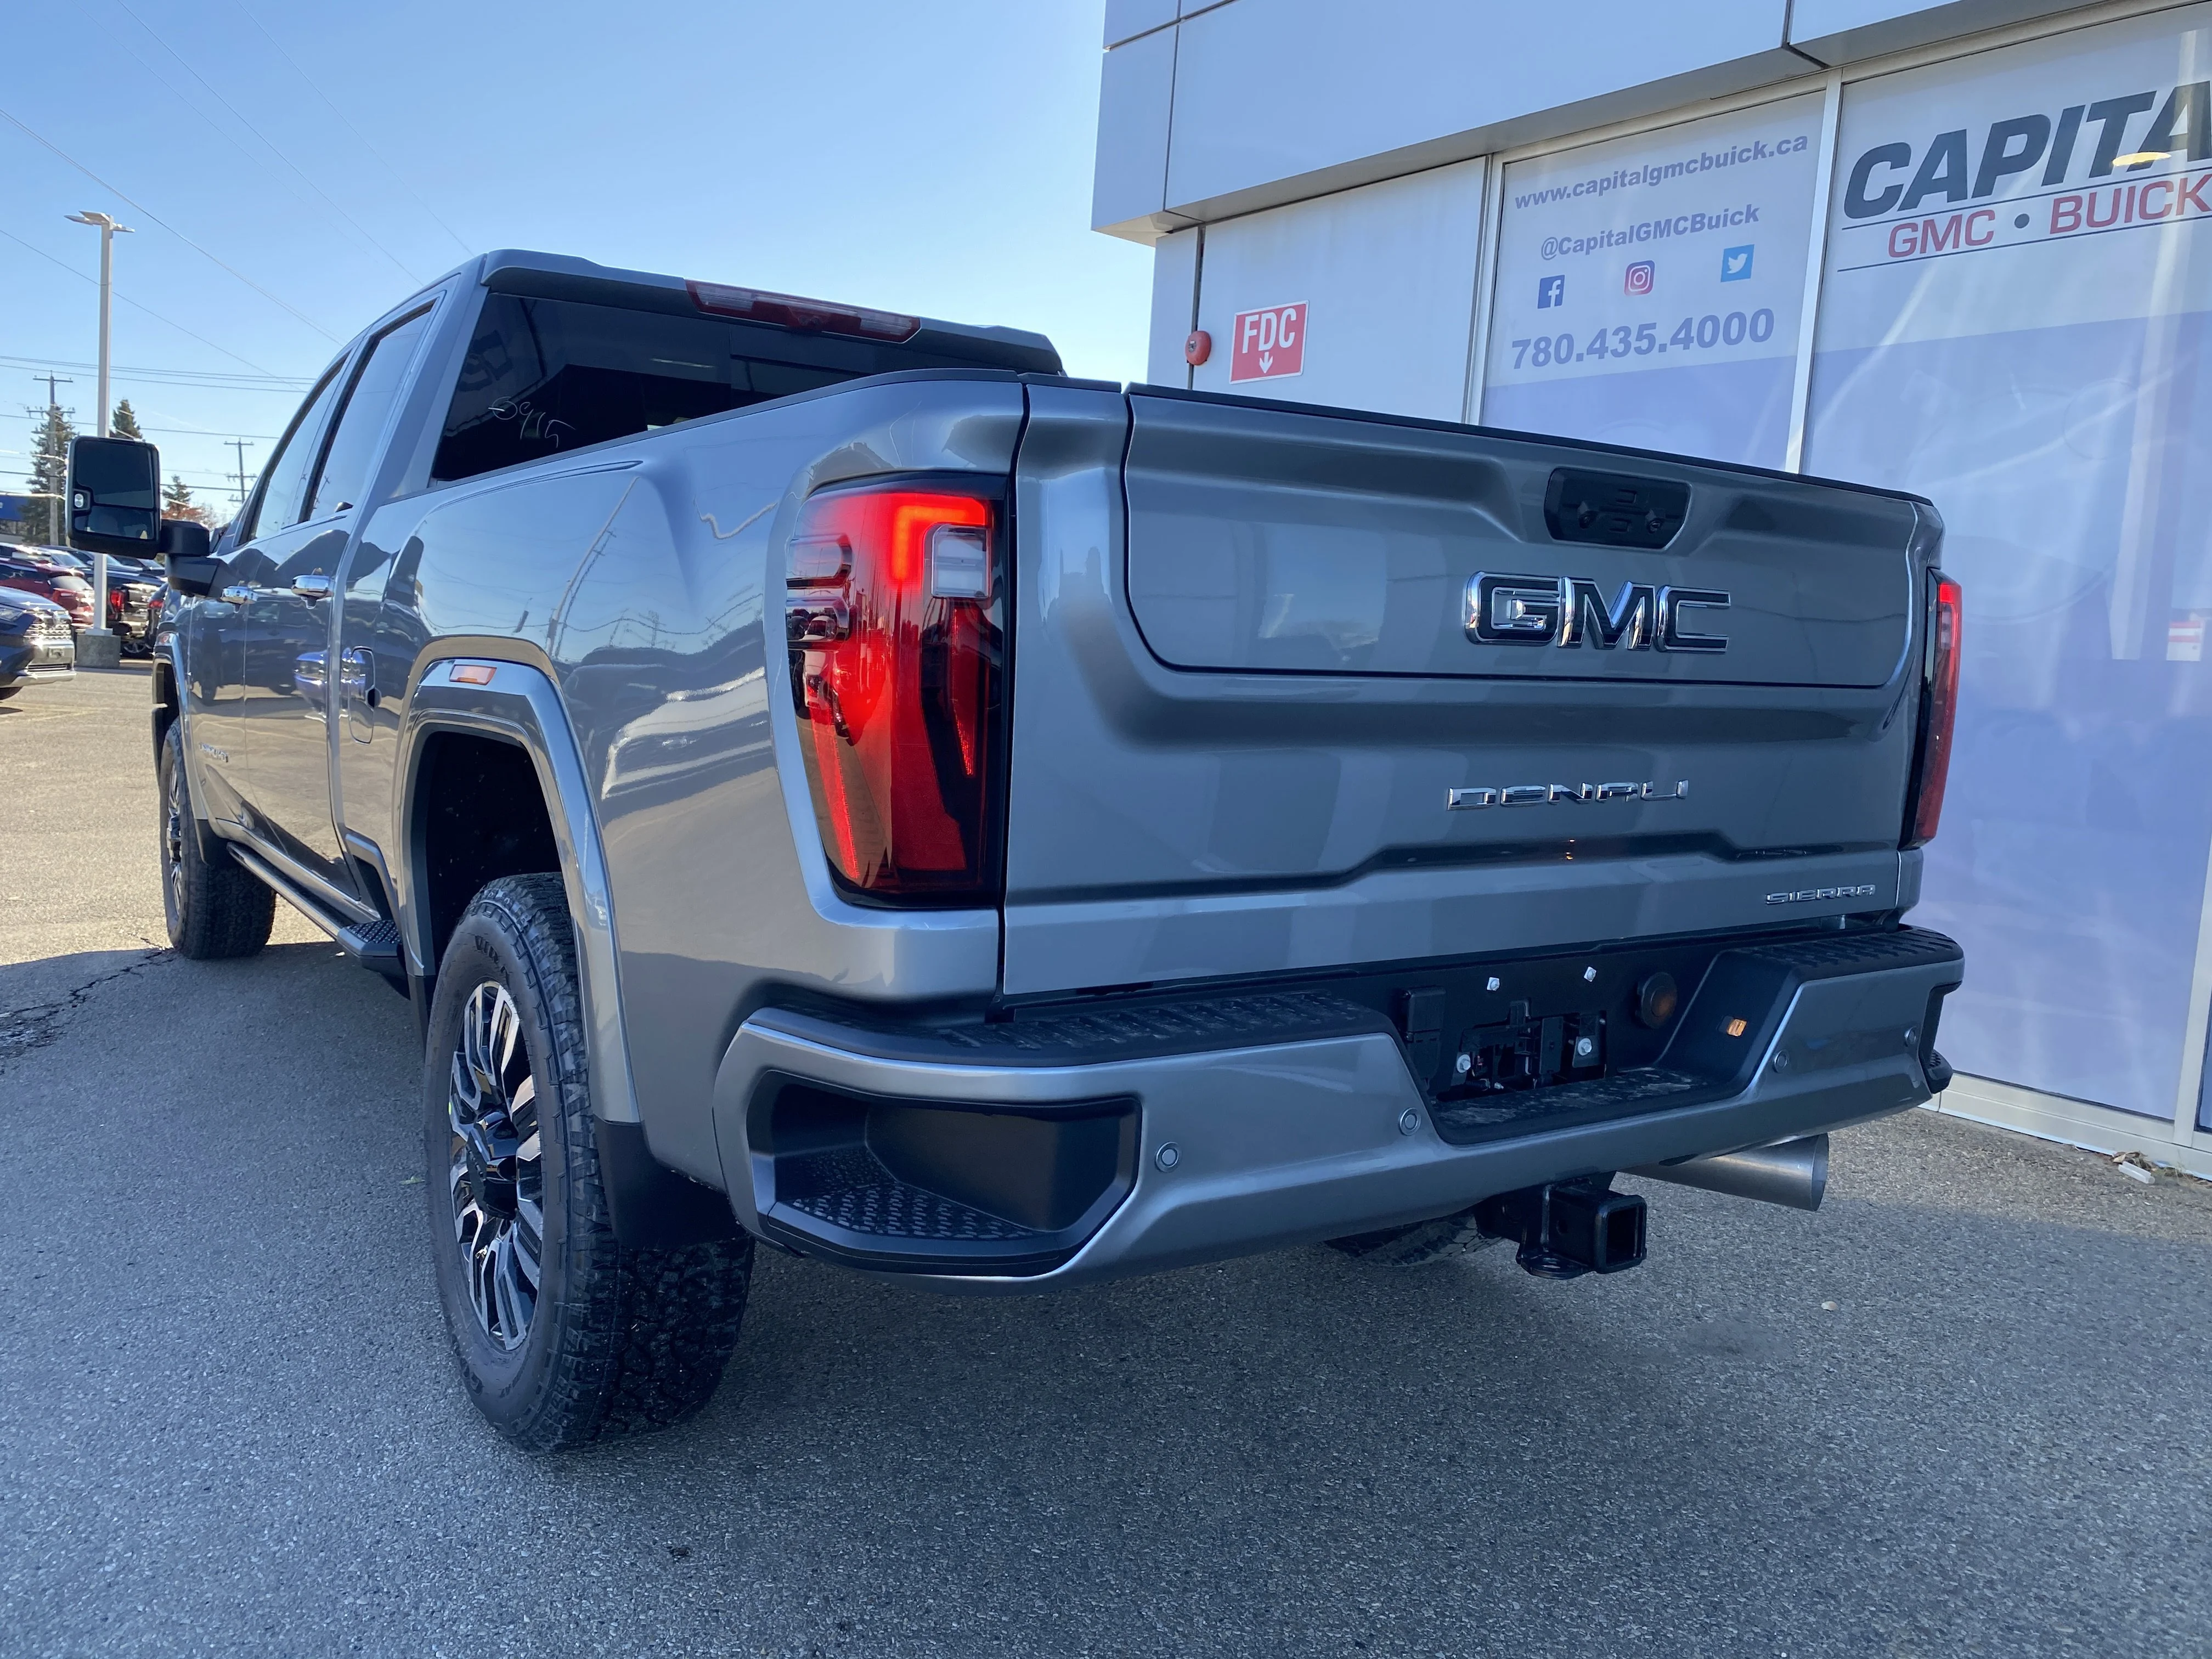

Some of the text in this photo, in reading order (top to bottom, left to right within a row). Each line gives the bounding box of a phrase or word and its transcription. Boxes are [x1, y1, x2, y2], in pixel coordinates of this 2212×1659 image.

[1515, 136, 1808, 208] www.capitalgmcbuick.ca
[1844, 81, 2212, 219] CAPITA
[1541, 204, 1760, 260] @CapitalGMCBuick
[1888, 174, 2212, 258] GMC BUICK
[1242, 308, 1296, 354] FDC
[1512, 308, 1774, 369] 780.435.4000
[1463, 571, 1731, 653] GMC
[1446, 779, 1689, 810] DENALI
[1765, 884, 1876, 905] SIERRA
